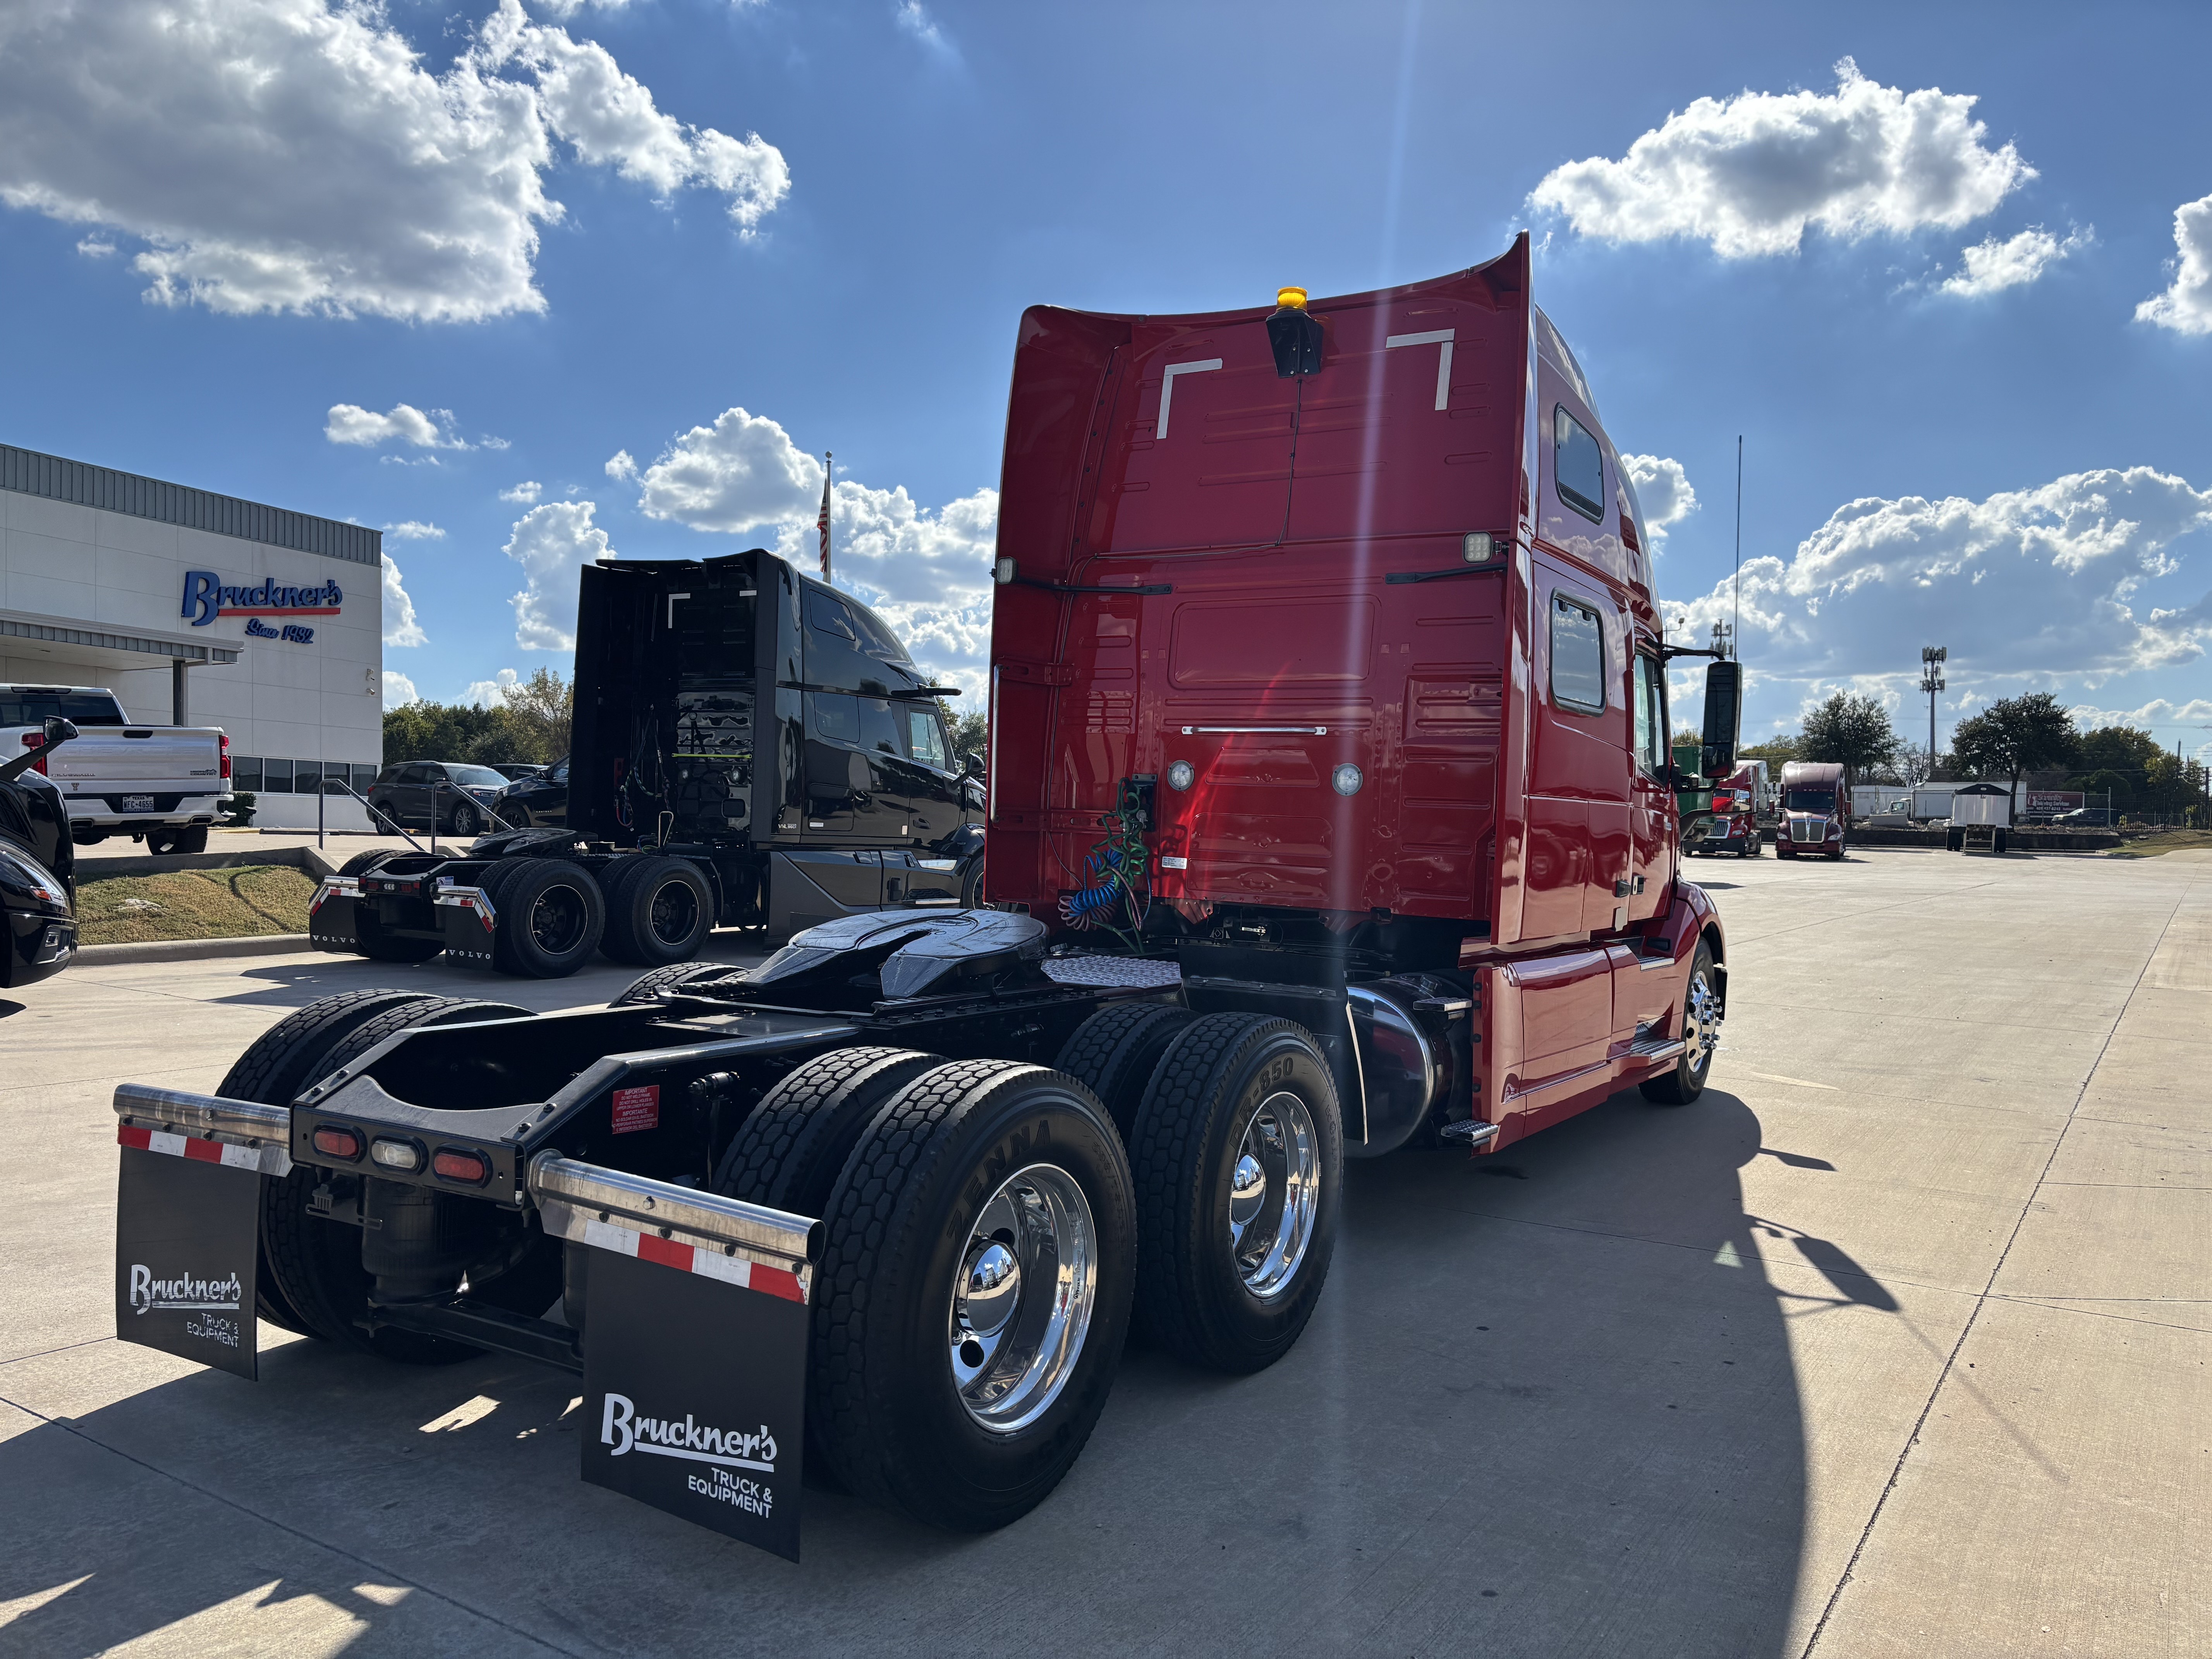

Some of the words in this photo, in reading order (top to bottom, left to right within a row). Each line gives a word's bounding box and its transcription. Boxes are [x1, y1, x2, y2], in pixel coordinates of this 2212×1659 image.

[182, 572, 342, 626] Bruckner's
[245, 618, 279, 639] Since
[313, 935, 355, 943] VOLVO
[449, 949, 491, 959] VOLVO
[946, 1119, 1051, 1244] ZENNA
[130, 1264, 241, 1315] Bruckner's
[187, 1321, 239, 1347] EQUIPMENT
[201, 1312, 230, 1330] TRUCK
[234, 1323, 239, 1335] &
[601, 1393, 777, 1461] Bruckner's
[688, 1475, 772, 1518] EQUIPMENT
[711, 1467, 759, 1498] TRUCK
[763, 1487, 773, 1503] &
